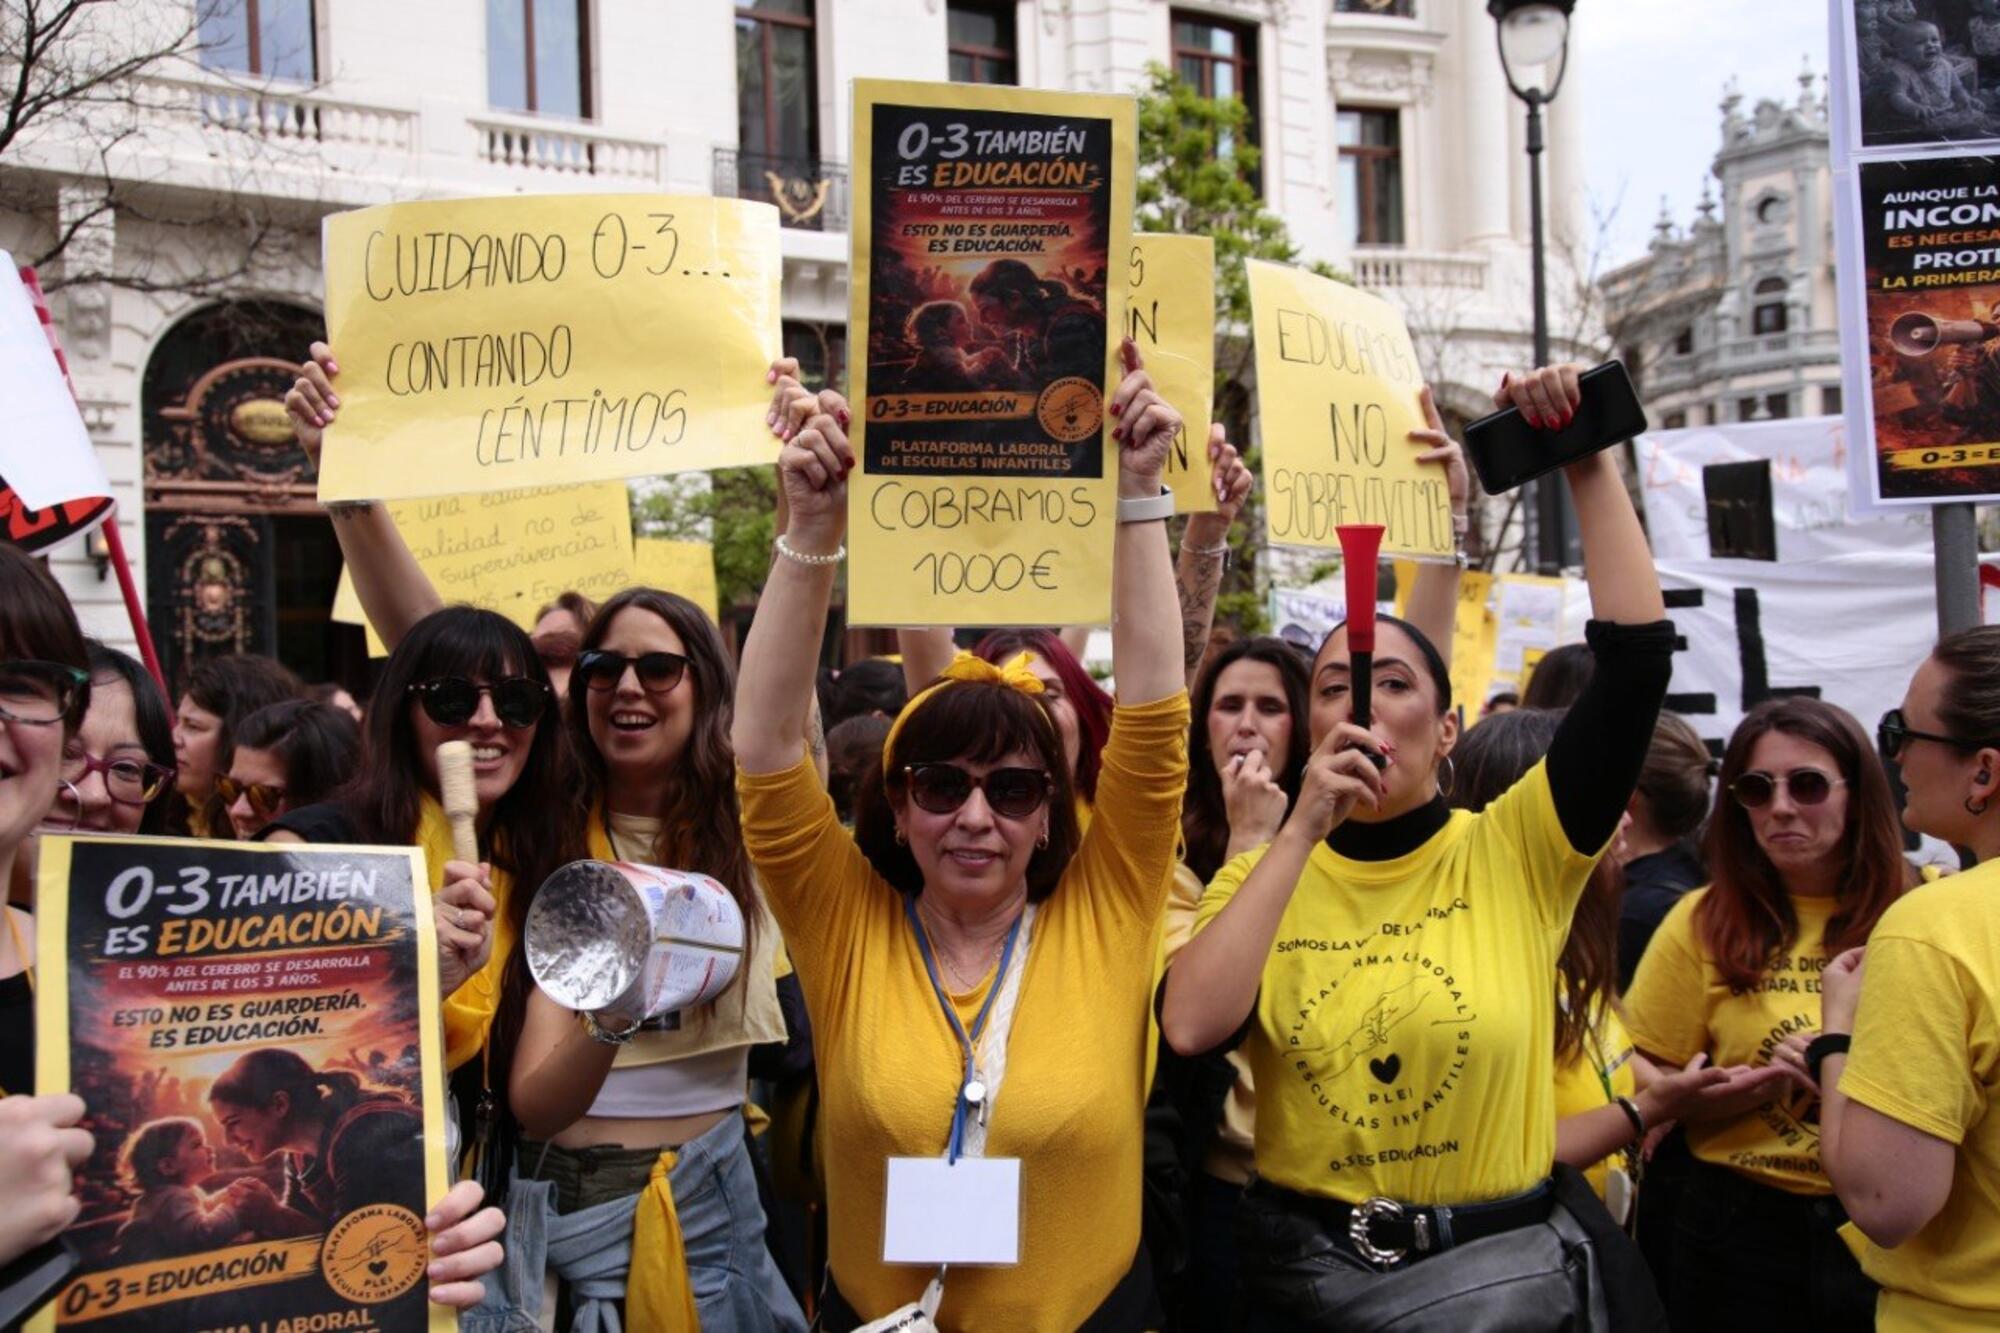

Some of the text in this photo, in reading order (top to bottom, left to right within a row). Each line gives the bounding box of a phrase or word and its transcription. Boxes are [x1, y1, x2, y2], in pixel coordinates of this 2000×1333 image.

[897, 122, 1087, 160] 0-3 TAMBIÉN
[898, 156, 1087, 188] ES EDUCACIÓN
[920, 193, 943, 204] 90%
[945, 195, 962, 204] DEL
[965, 195, 1005, 205] CEREBRO
[1020, 196, 1079, 207] DESARROLLA
[1882, 185, 1998, 204] AUNQUE LA
[940, 205, 970, 215] ANTES
[972, 206, 983, 216] DE
[986, 206, 1004, 216] LOS
[1007, 206, 1013, 216] 3
[902, 221, 1075, 238] ESTO NO ES GUARDERÍA.
[1888, 235, 1914, 248] ES
[928, 237, 1046, 253] ES EDUCACIÓN.
[365, 230, 566, 301] CUIDANDO
[1882, 276, 1907, 288] LA
[386, 324, 572, 396] CONTANDO
[891, 440, 1068, 456] PLATAFORMA LABORAL
[1330, 402, 1387, 467] NO
[881, 456, 1072, 470] DE ESCUELAS INFANTILES
[1920, 449, 1968, 464] 0-3
[871, 481, 1096, 531] COBRAMOS
[105, 863, 378, 920] 0-3 TAMBIÉN
[105, 902, 384, 956] ES EDUCACIÓN
[1277, 938, 1329, 953] SOMOS
[1332, 941, 1351, 951] LA
[1382, 923, 1401, 936] DE
[119, 955, 371, 979] EL 90% DEL CEREBRO SE DESARROLLA
[165, 972, 322, 993] ANTES DE LOS 3 AÑOS.
[113, 989, 367, 1027] ESTO NO ES GUARDERÍA.
[150, 1016, 325, 1048] ES EDUCACIÓN.
[1296, 1060, 1381, 1130] ESCUELAS
